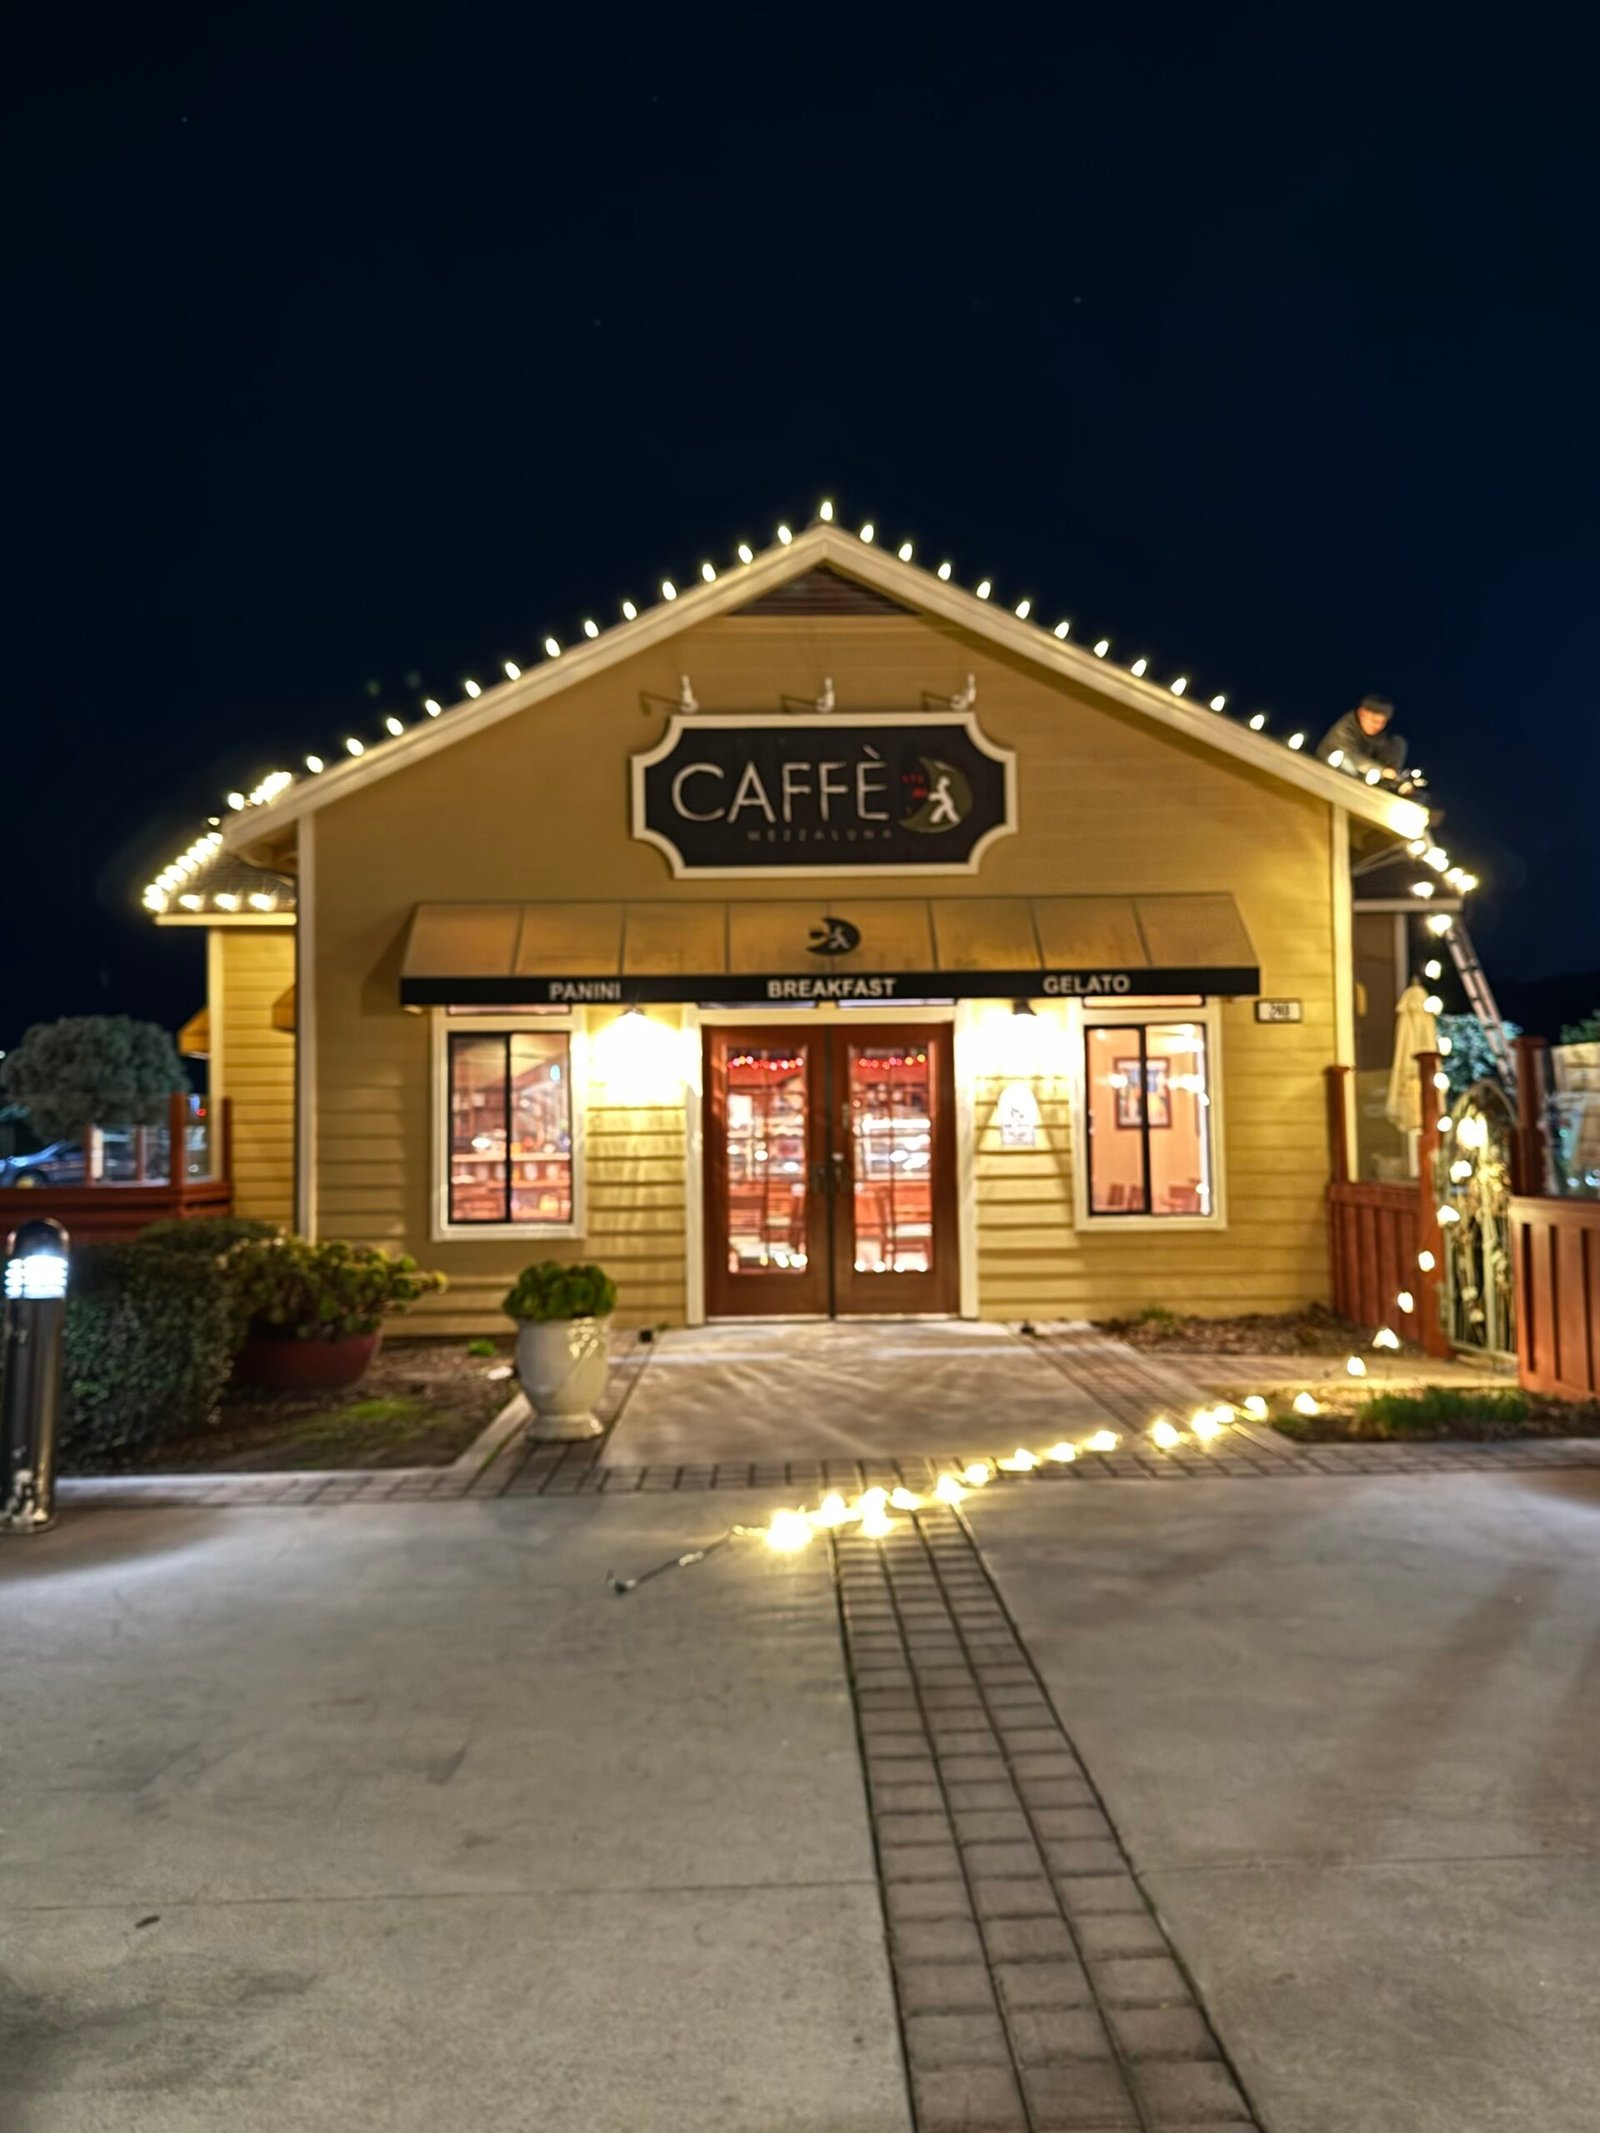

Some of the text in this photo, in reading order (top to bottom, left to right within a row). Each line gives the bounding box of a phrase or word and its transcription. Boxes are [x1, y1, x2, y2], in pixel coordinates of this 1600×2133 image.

[672, 745, 889, 823] CAFFÈ
[550, 984, 621, 1000] PANINI
[767, 979, 896, 999] BREAKFAST
[1043, 974, 1131, 994] GELATO
